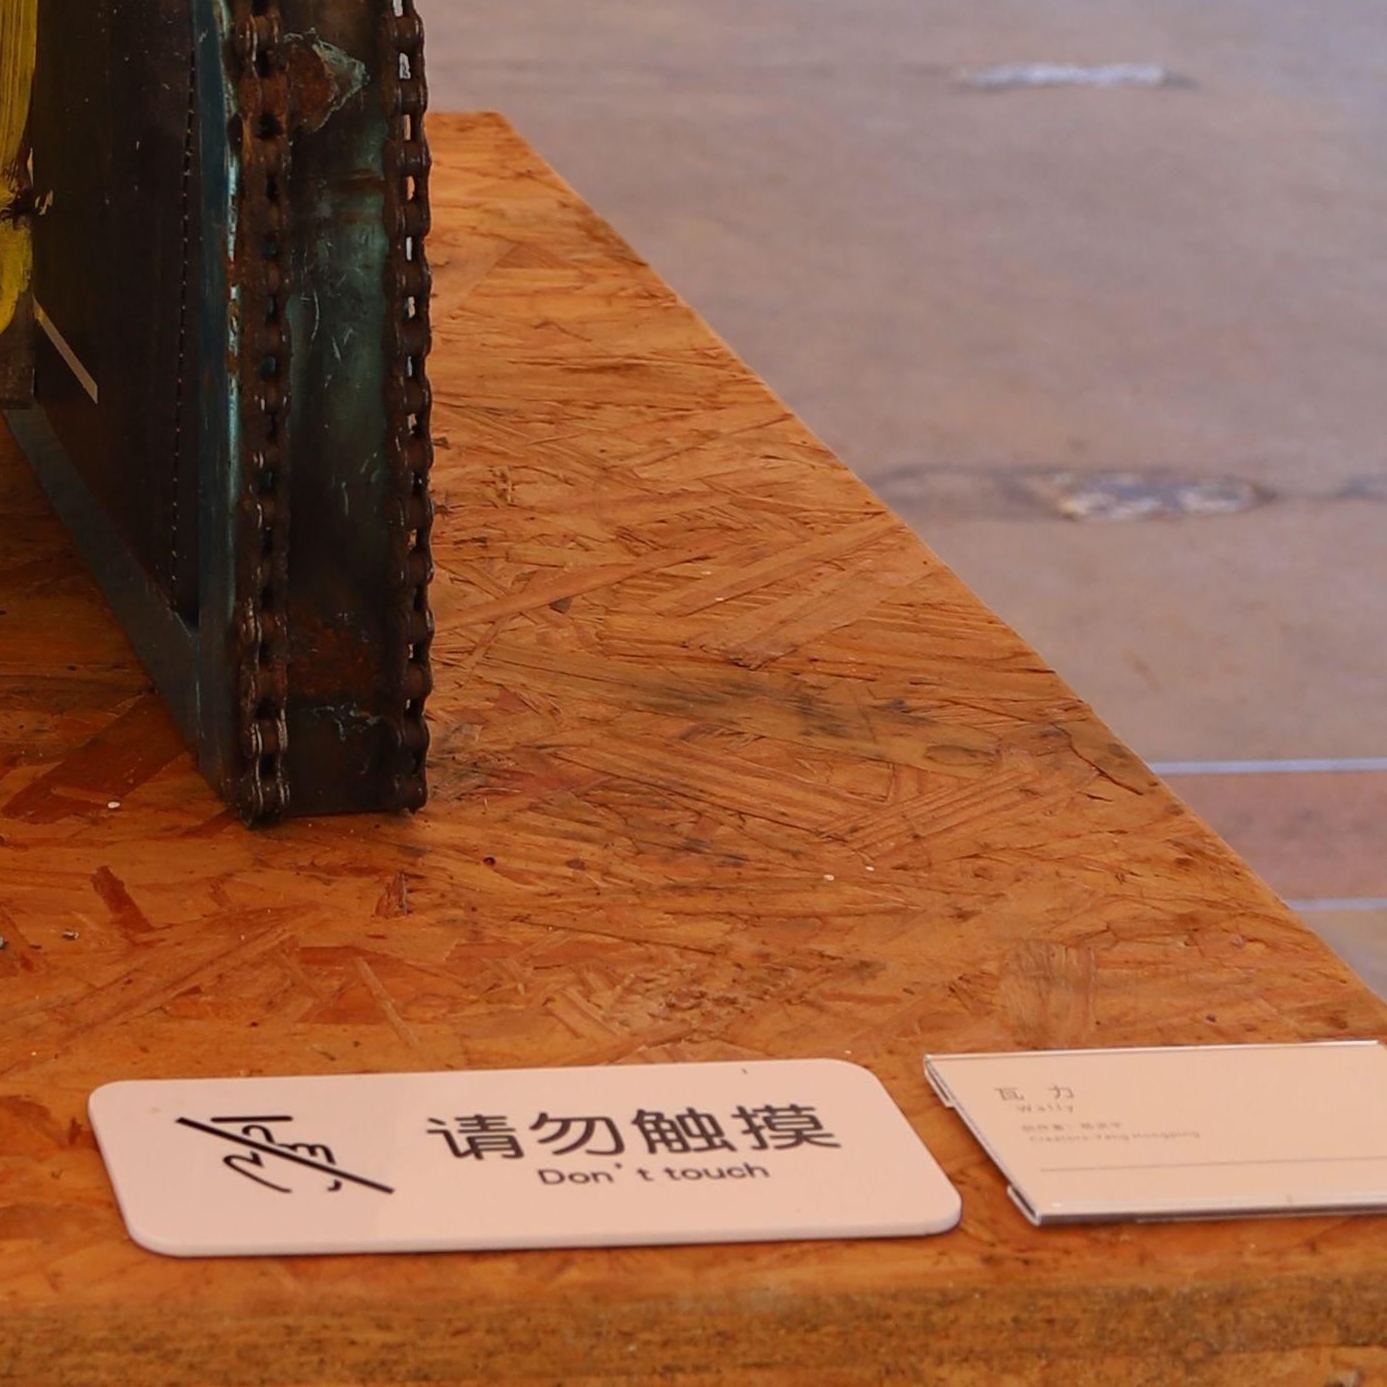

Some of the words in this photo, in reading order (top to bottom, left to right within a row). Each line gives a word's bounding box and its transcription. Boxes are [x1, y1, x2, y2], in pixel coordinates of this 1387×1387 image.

[1014, 1103, 1075, 1115] Wally
[425, 1103, 842, 1161] 请勿触摸
[664, 1162, 770, 1182] touch
